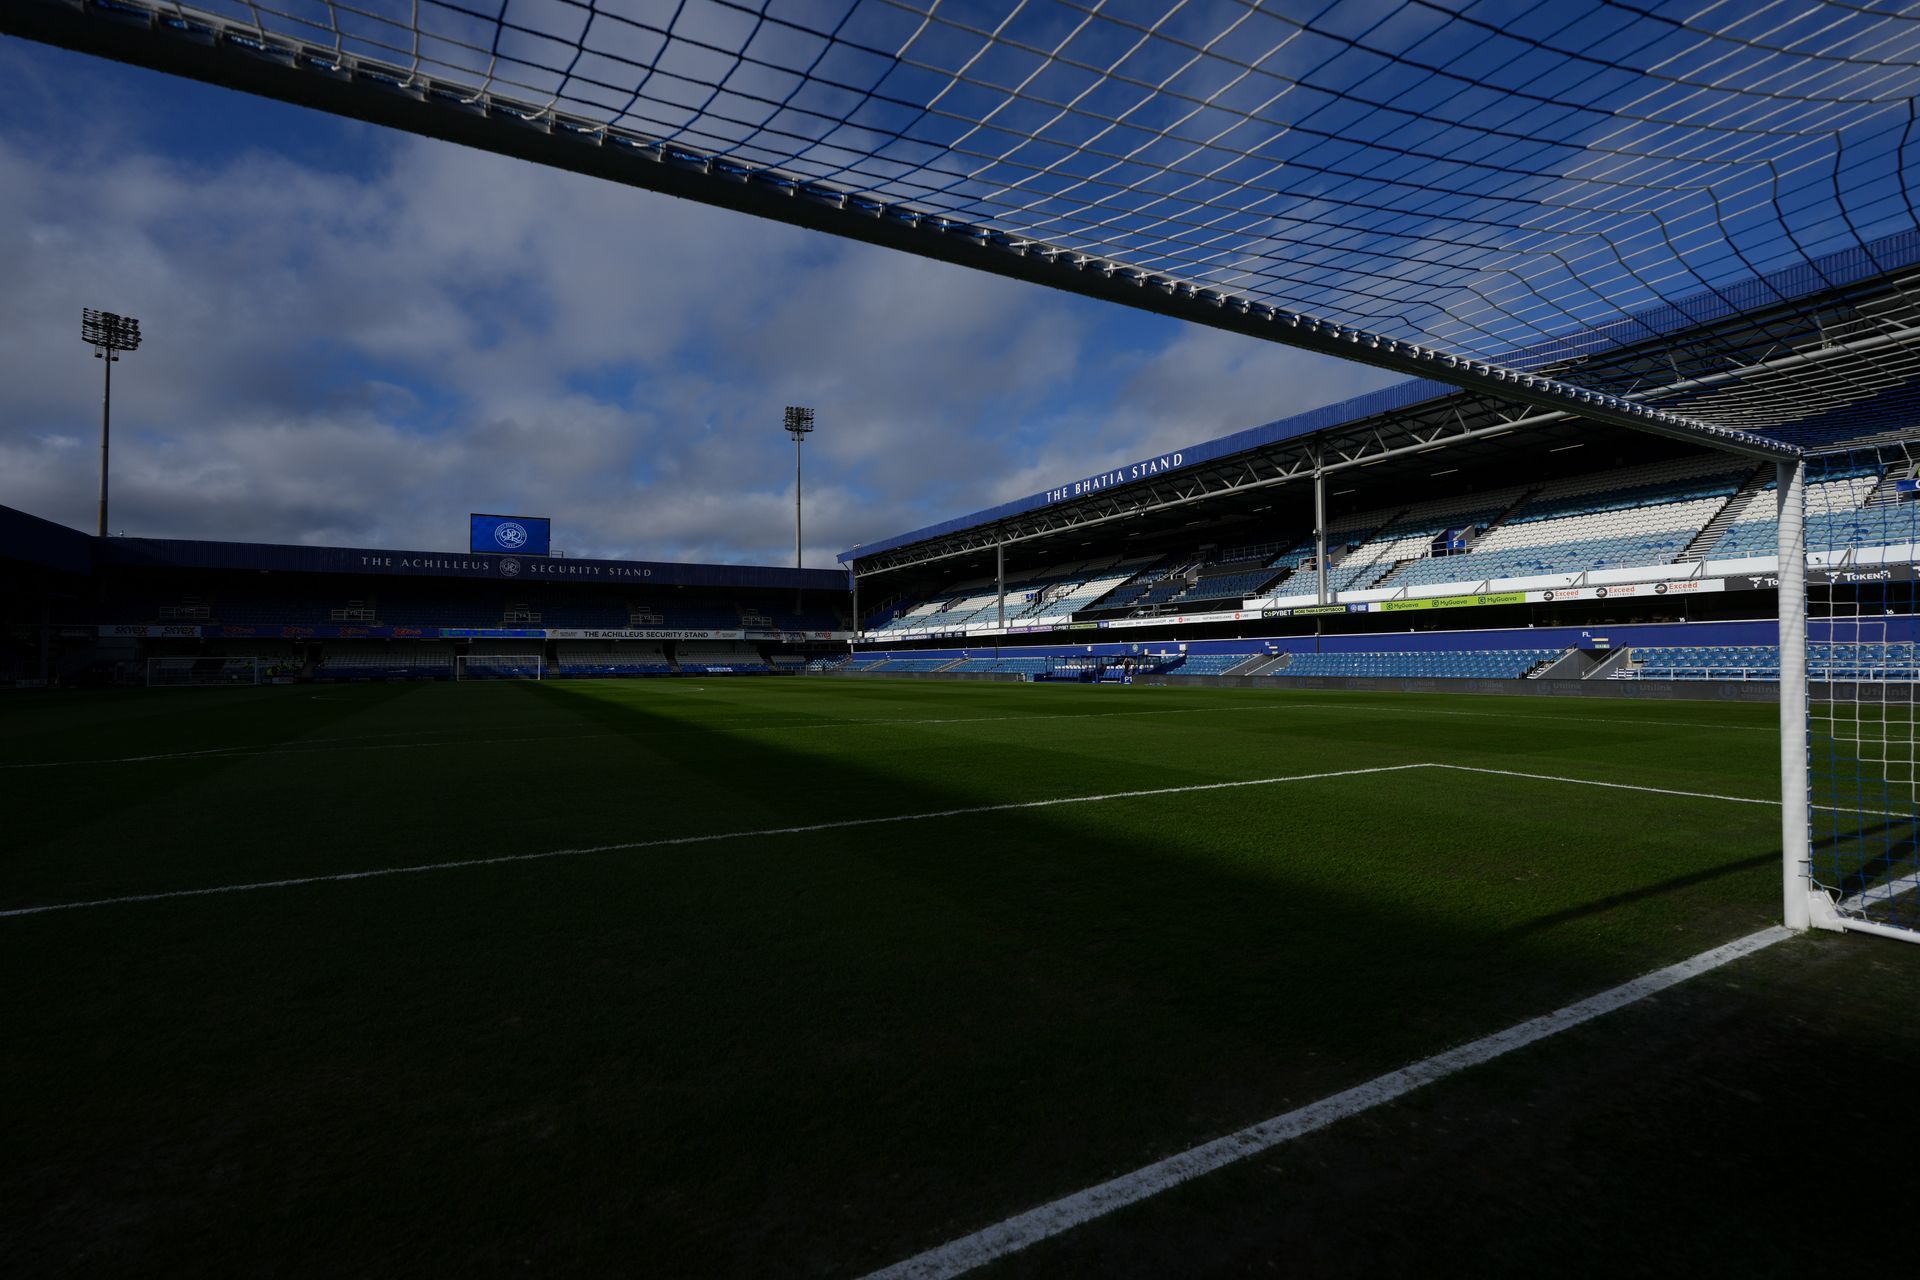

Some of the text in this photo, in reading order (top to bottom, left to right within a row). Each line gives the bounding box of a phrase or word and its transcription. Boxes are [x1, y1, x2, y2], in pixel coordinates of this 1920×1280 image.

[1046, 453, 1183, 503] THE BHATIA STAND
[361, 556, 652, 577] THE ACHILLEUS SECURITY STAND
[1263, 609, 1292, 617] COPYBET
